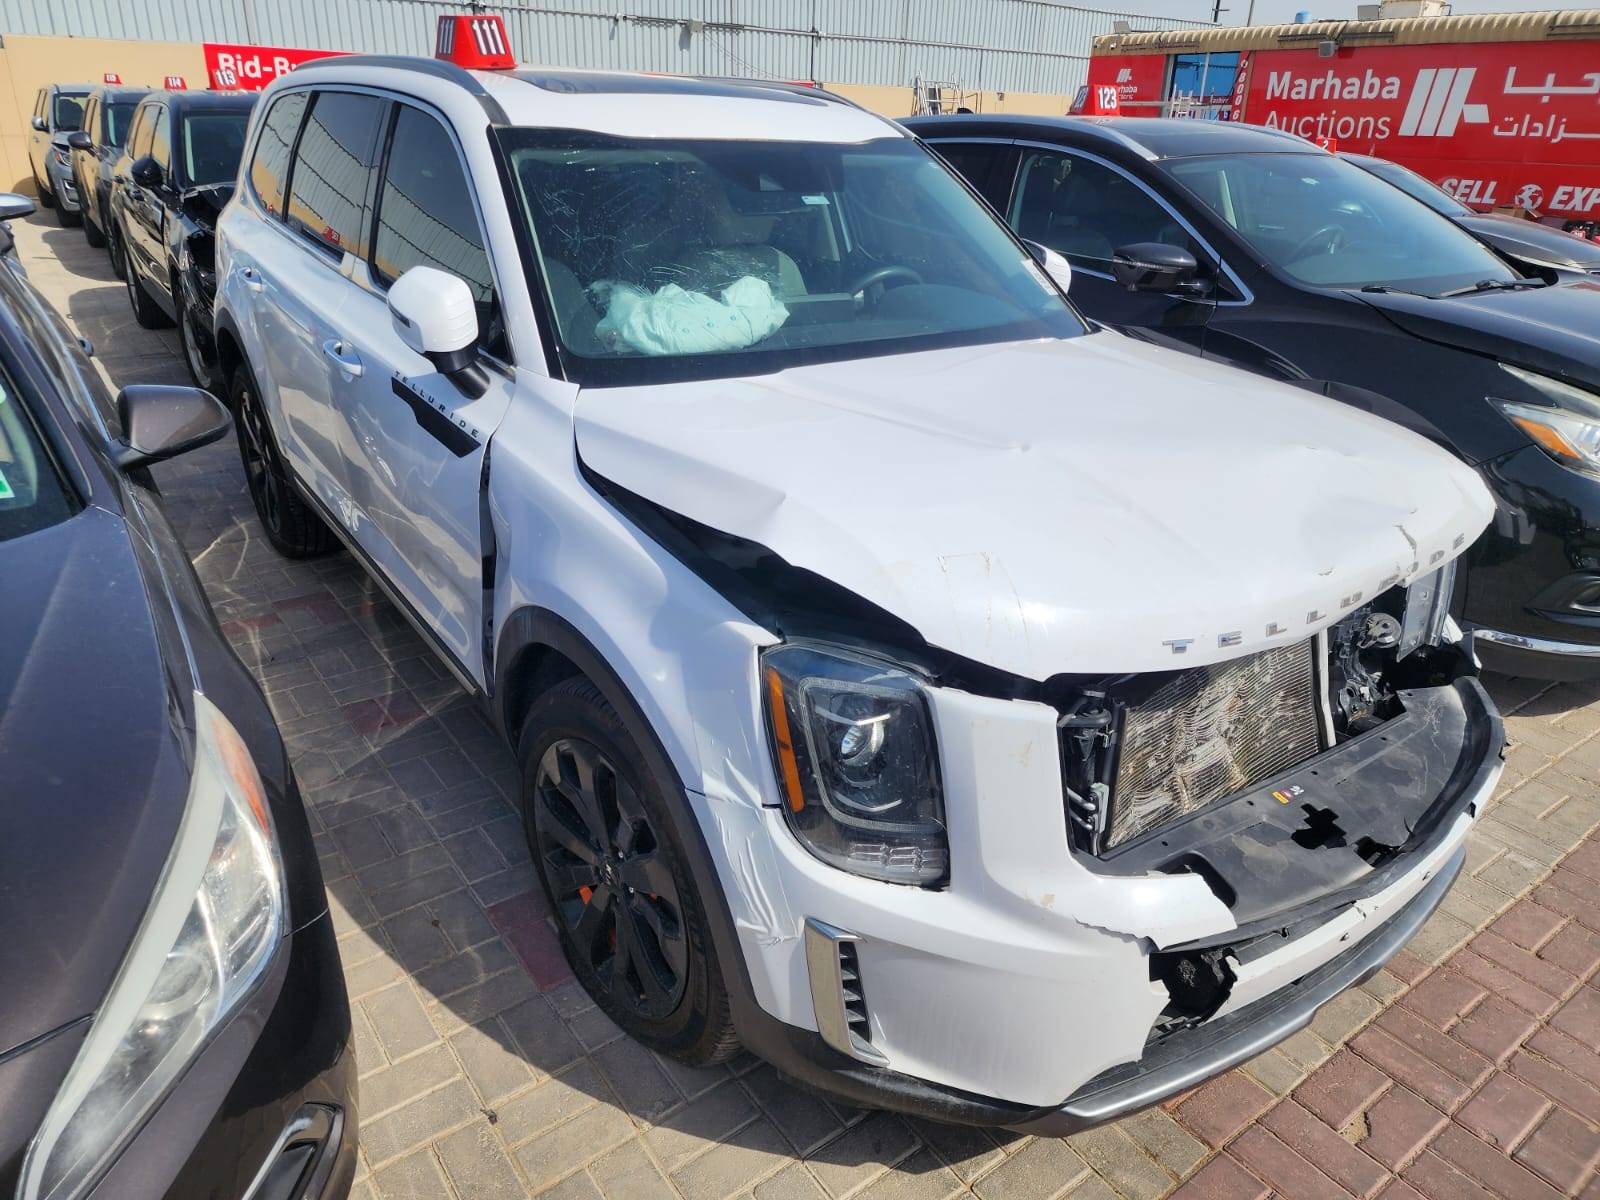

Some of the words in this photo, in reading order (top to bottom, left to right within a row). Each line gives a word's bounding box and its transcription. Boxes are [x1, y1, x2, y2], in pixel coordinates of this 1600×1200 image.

[472, 19, 506, 55] 111
[216, 69, 237, 86] 113
[217, 53, 297, 79] Bid-B
[1098, 87, 1117, 110] 123
[1266, 69, 1401, 100] Marhaba
[1264, 110, 1392, 140] Auctions
[1441, 179, 1498, 205] SELL
[392, 370, 480, 439] TELLURIDE
[1162, 532, 1466, 655] TELLURIDE
